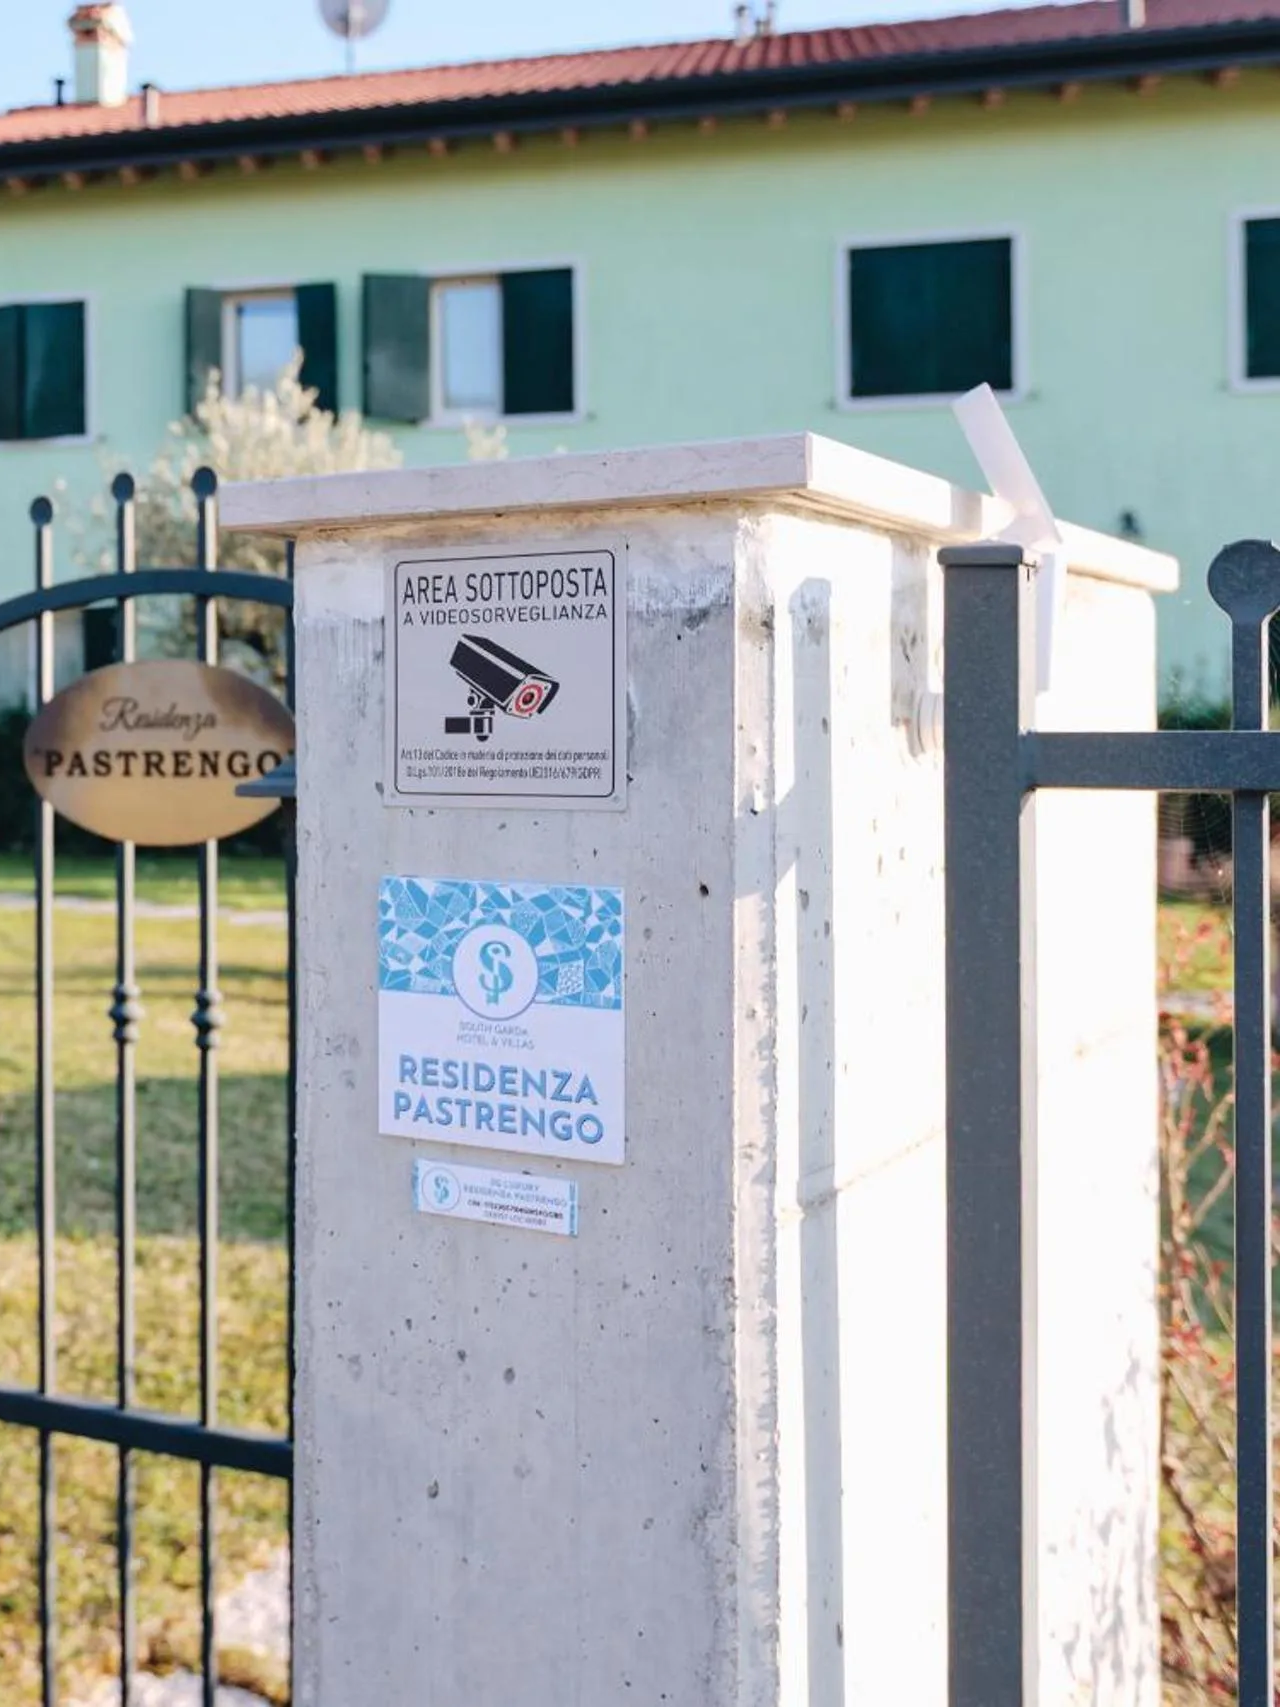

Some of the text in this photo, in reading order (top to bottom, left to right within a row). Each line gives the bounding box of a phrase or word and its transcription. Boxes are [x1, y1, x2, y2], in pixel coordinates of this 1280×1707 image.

[403, 567, 608, 605] AREA SOTTOPOSTA
[403, 603, 608, 626] A VIDEOSORVEGLIANZA
[99, 696, 218, 741] Residenza
[456, 1033, 489, 1047] HOTEL
[459, 1021, 528, 1036] SOUTH GARDA
[398, 1054, 598, 1106] RESIDENZA
[393, 1089, 604, 1144] PASTRENGO
